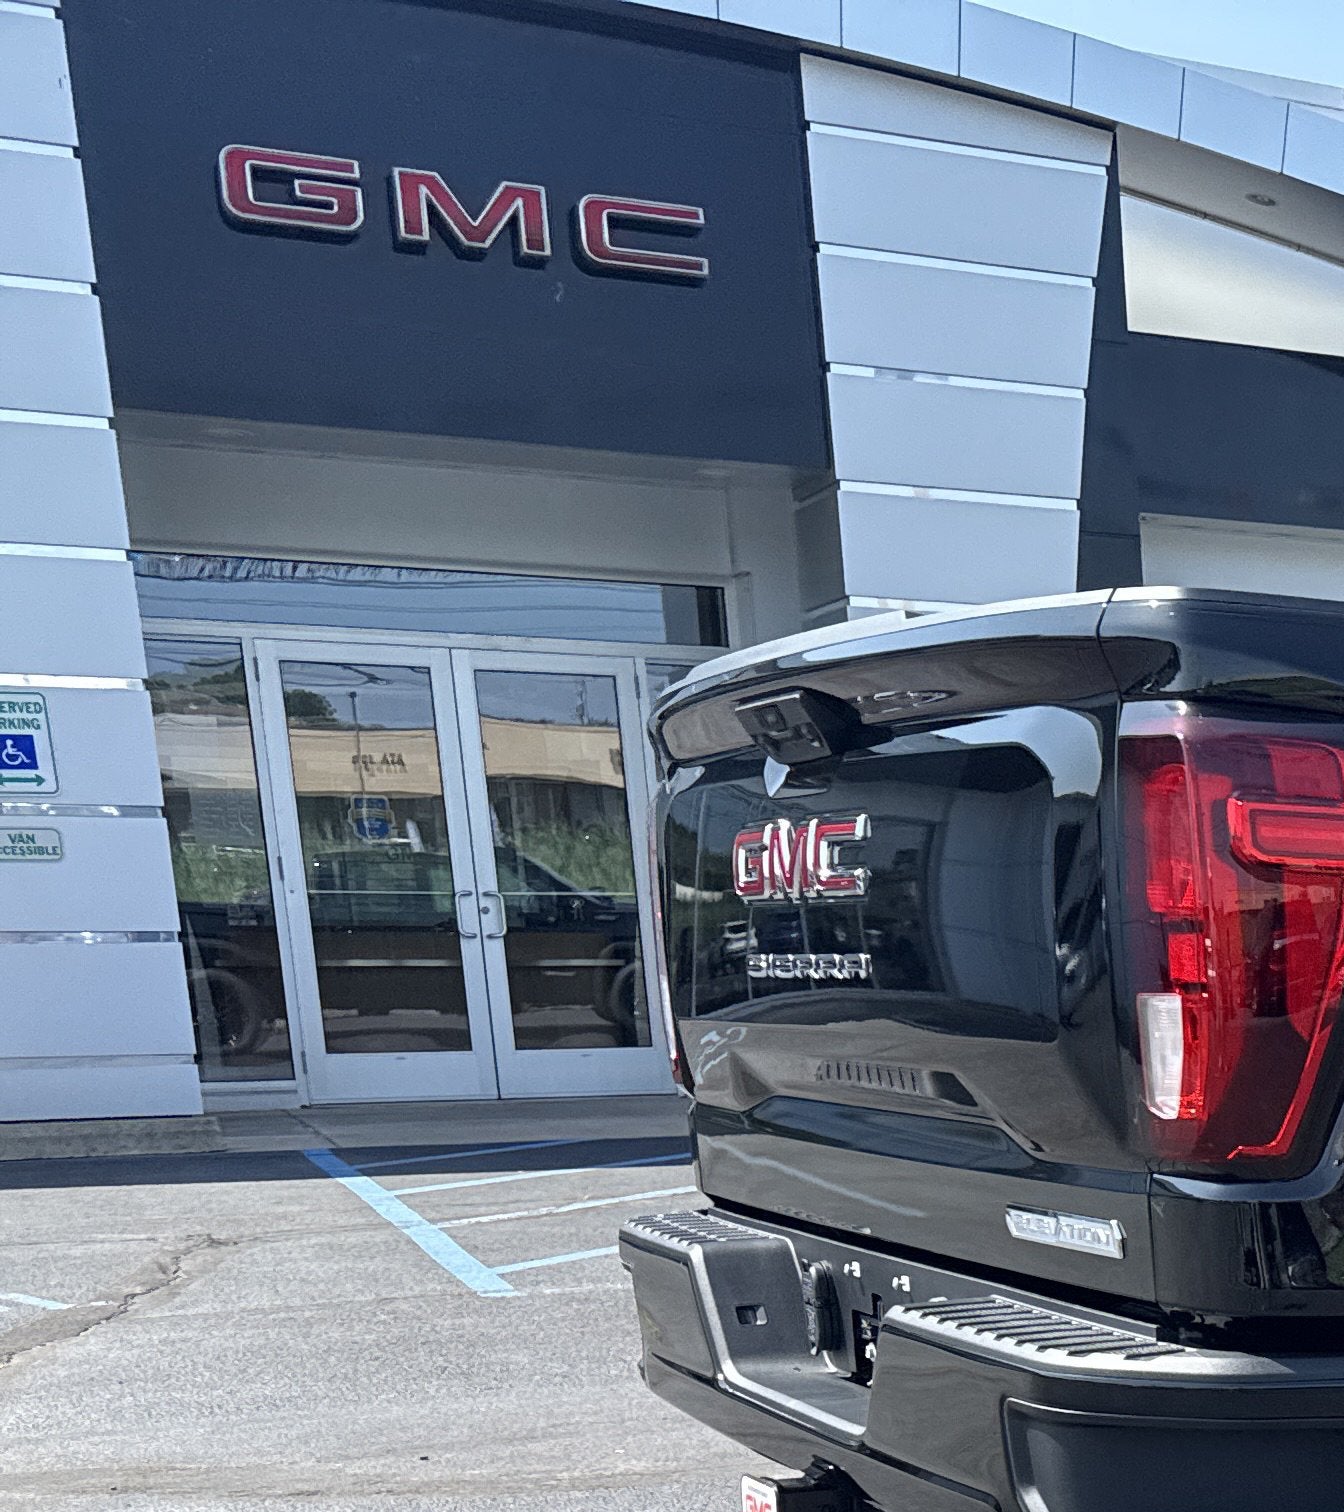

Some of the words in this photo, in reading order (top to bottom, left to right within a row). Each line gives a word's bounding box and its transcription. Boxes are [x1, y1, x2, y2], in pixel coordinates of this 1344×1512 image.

[219, 144, 710, 276] GMC
[0, 701, 43, 714] ERVED
[0, 717, 41, 730] RKING
[7, 833, 36, 845] VAN
[0, 845, 60, 856] CESSIBLE
[733, 812, 873, 904] GMC
